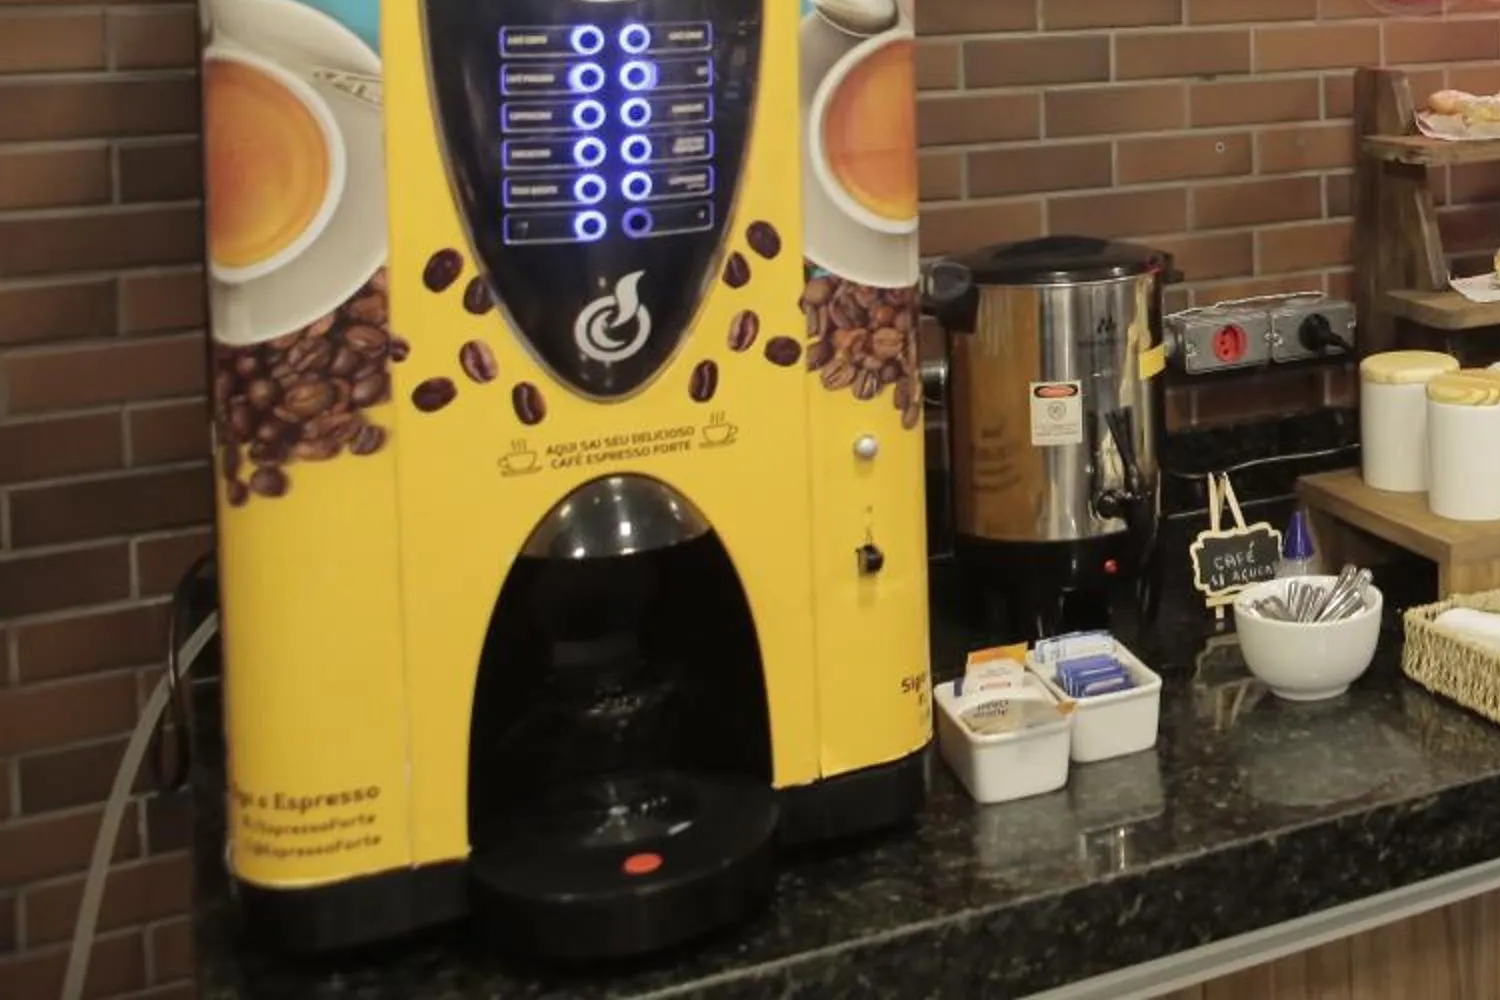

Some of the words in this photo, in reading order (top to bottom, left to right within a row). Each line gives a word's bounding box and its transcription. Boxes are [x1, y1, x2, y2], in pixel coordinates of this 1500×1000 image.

[546, 441, 577, 457] AQUI
[580, 439, 601, 452] SAI
[604, 434, 629, 448] SEU
[632, 426, 696, 444] DELICIOSO
[586, 446, 651, 464] ESPRESSO
[653, 439, 691, 454] FORTE
